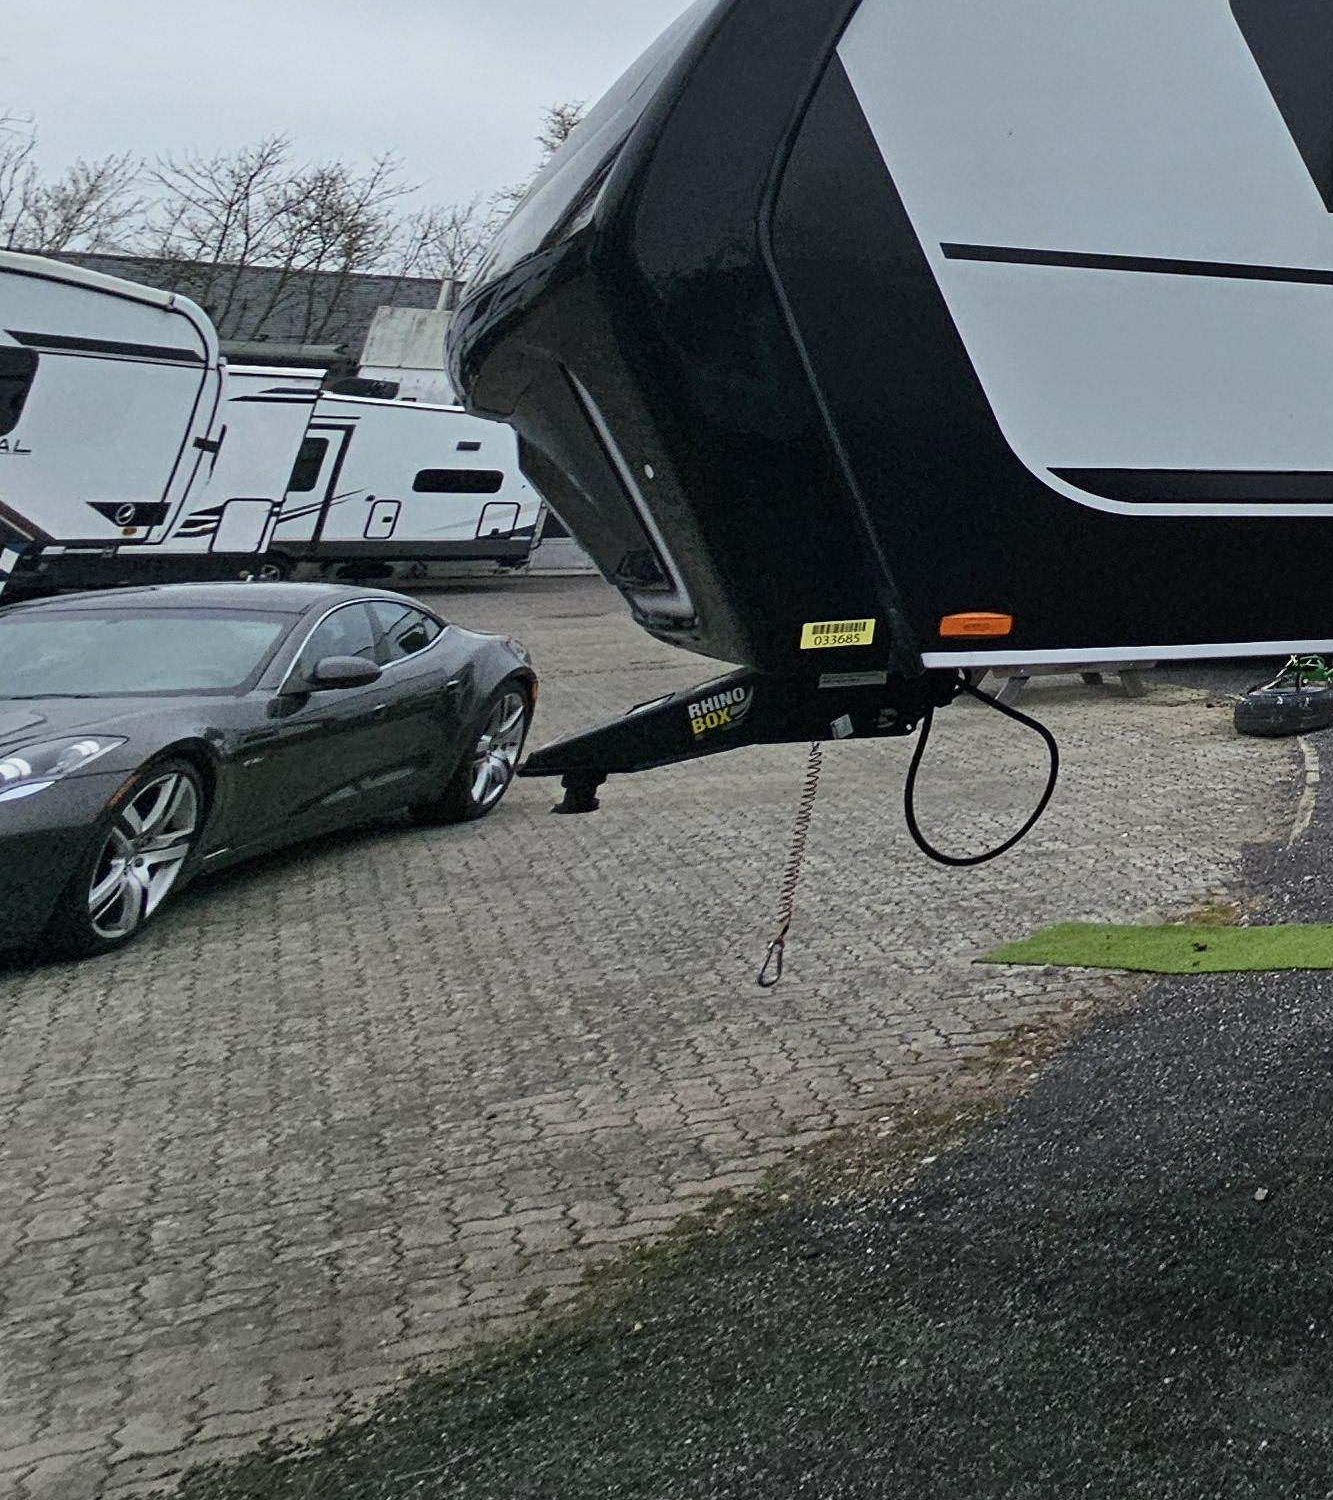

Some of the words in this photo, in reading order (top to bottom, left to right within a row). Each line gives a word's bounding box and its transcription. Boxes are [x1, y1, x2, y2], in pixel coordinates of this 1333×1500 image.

[814, 633, 860, 646] 033685
[688, 687, 745, 718] RHINO
[692, 707, 732, 734] BOX
